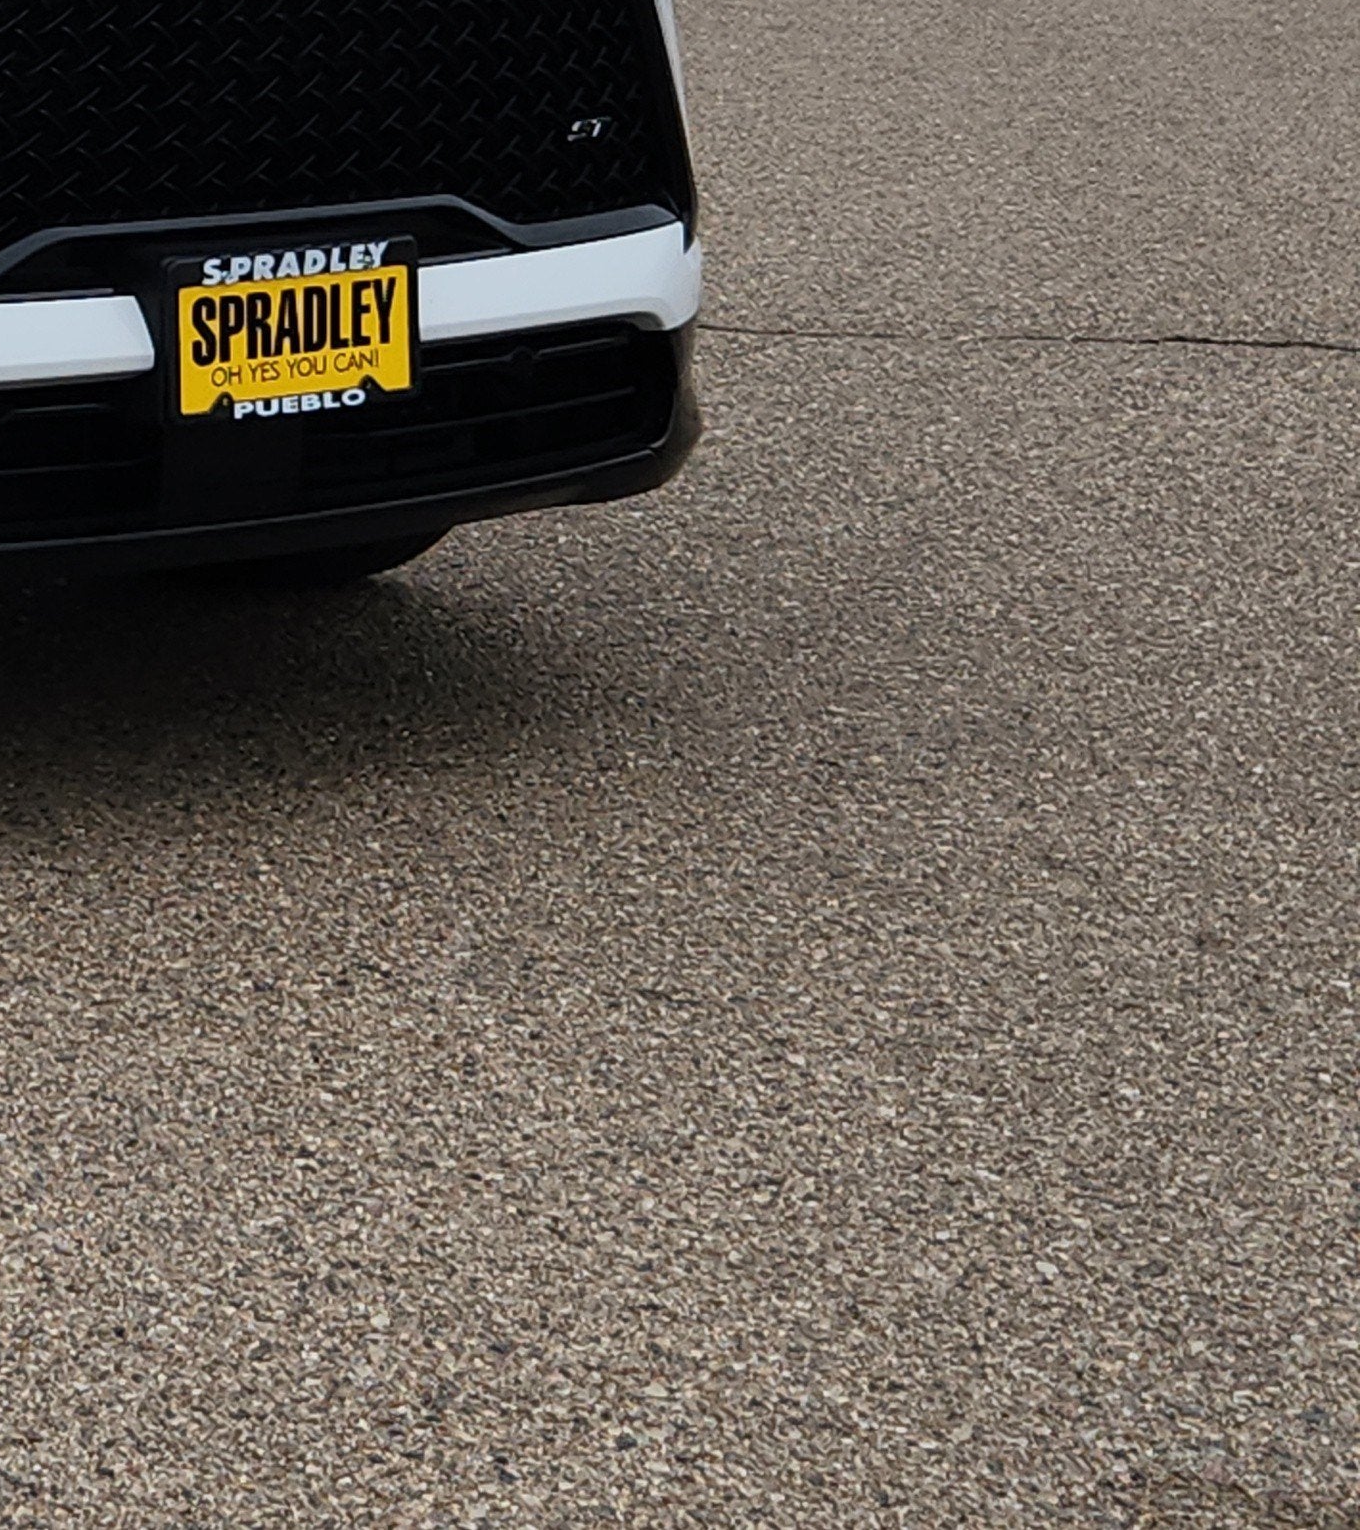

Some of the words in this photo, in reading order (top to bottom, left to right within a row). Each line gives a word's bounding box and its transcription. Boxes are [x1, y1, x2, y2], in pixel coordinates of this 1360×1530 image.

[202, 241, 389, 286] SPRADLEY
[191, 276, 397, 367] SPRADLEY
[211, 364, 243, 387] OH
[248, 360, 281, 383] YES
[286, 355, 328, 380] YOU
[333, 349, 380, 374] CAN!
[233, 388, 366, 419] PUEBLO
